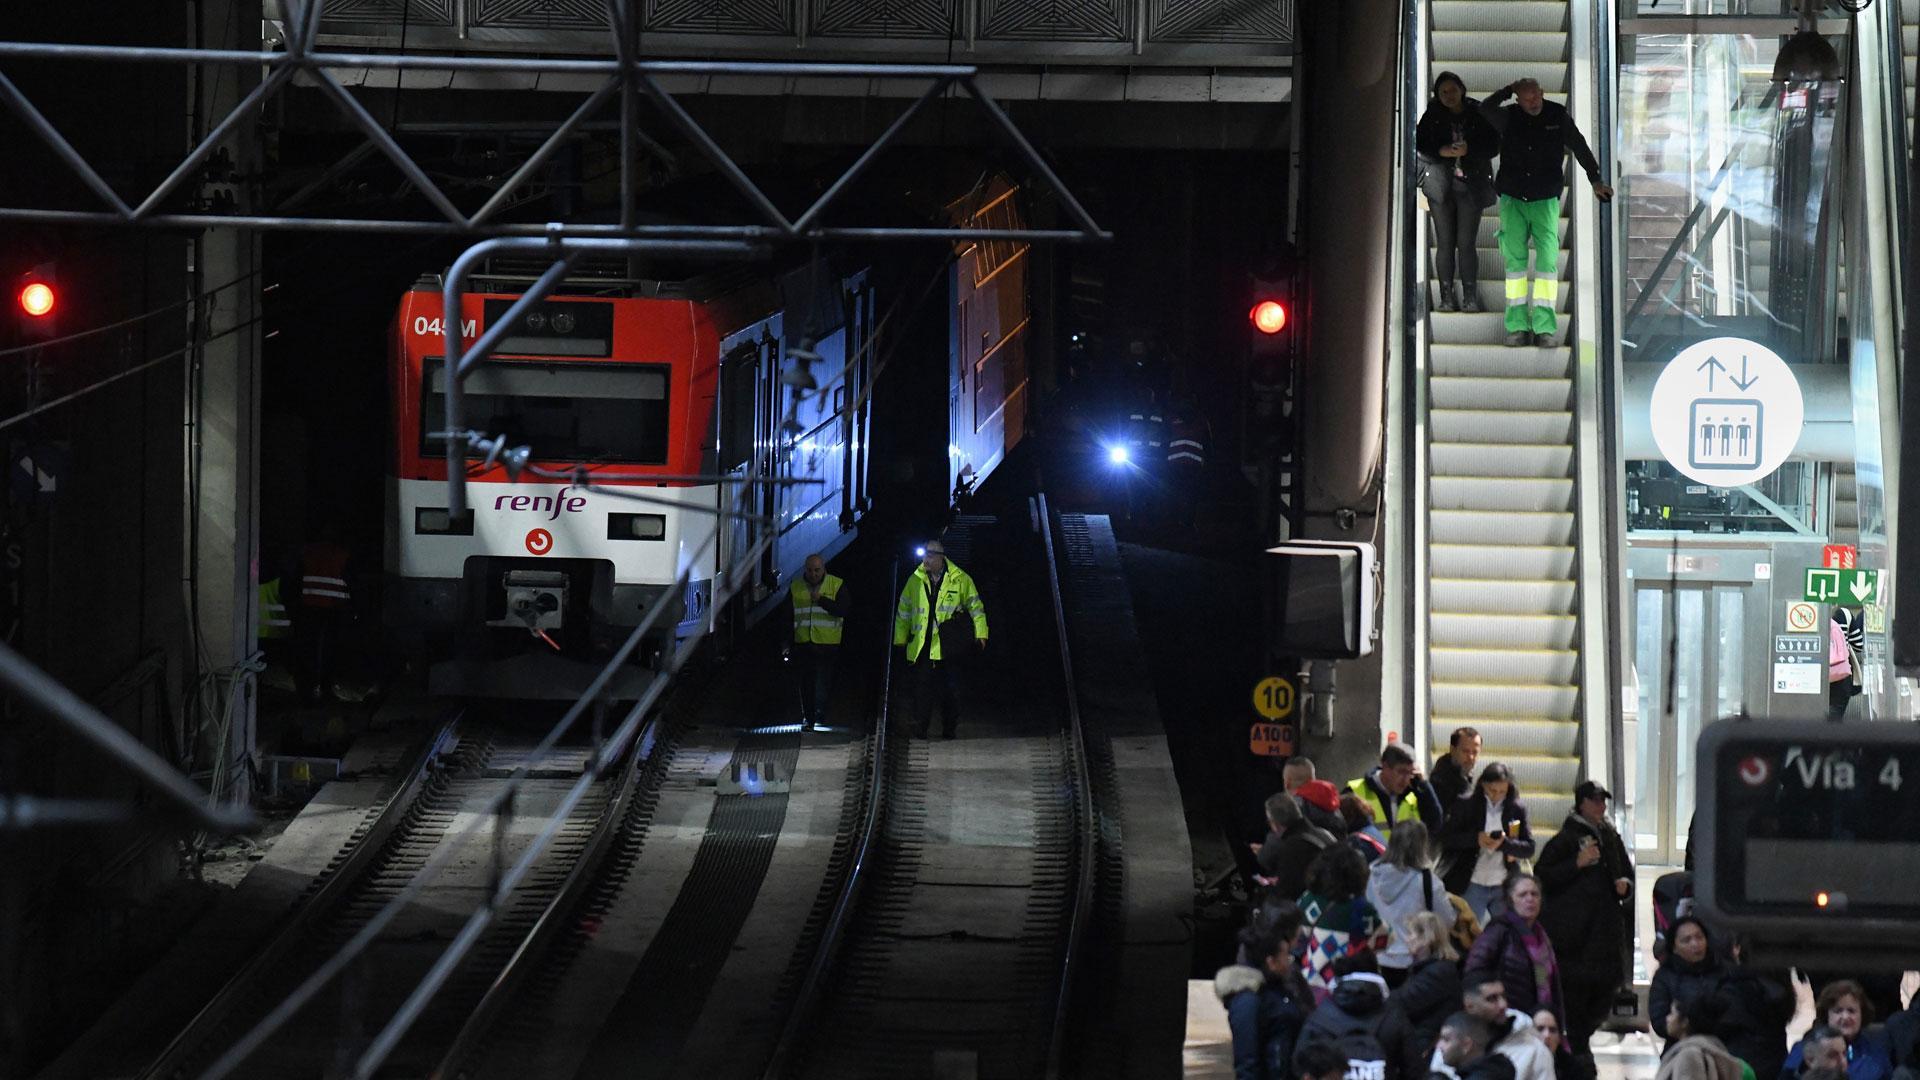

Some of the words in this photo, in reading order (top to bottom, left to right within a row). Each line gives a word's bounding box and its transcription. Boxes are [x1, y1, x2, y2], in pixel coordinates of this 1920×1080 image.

[495, 486, 587, 521] renfe
[1263, 685, 1290, 710] 10
[1252, 726, 1291, 742] A100
[1879, 757, 1903, 791] 4
